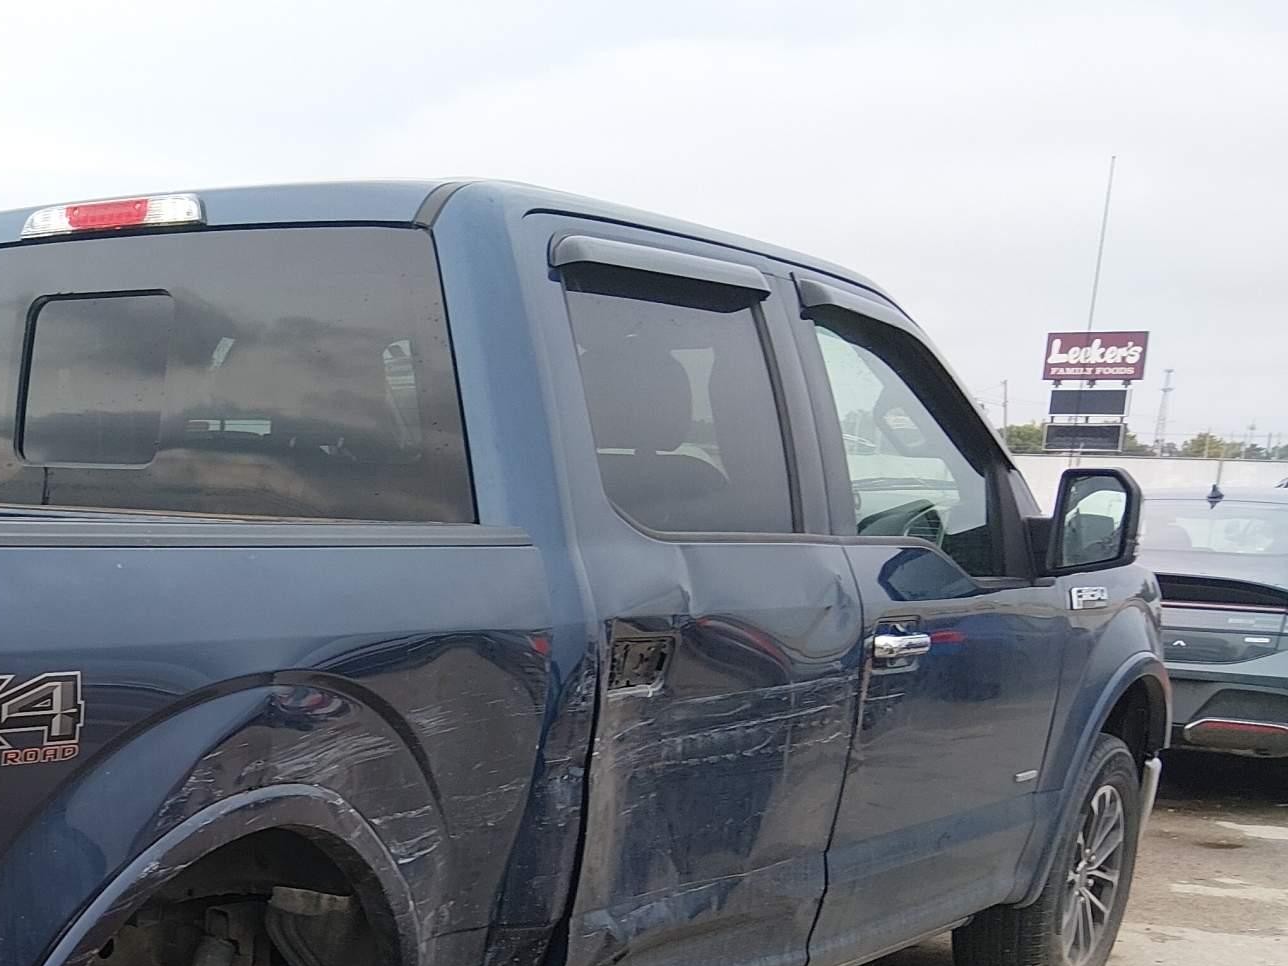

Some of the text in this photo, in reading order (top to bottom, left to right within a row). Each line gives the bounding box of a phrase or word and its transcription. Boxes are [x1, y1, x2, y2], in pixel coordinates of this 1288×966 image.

[1047, 338, 1143, 364] Leeker's
[1050, 367, 1135, 375] FAMILY FOODS
[1, 745, 80, 766] ROAD
